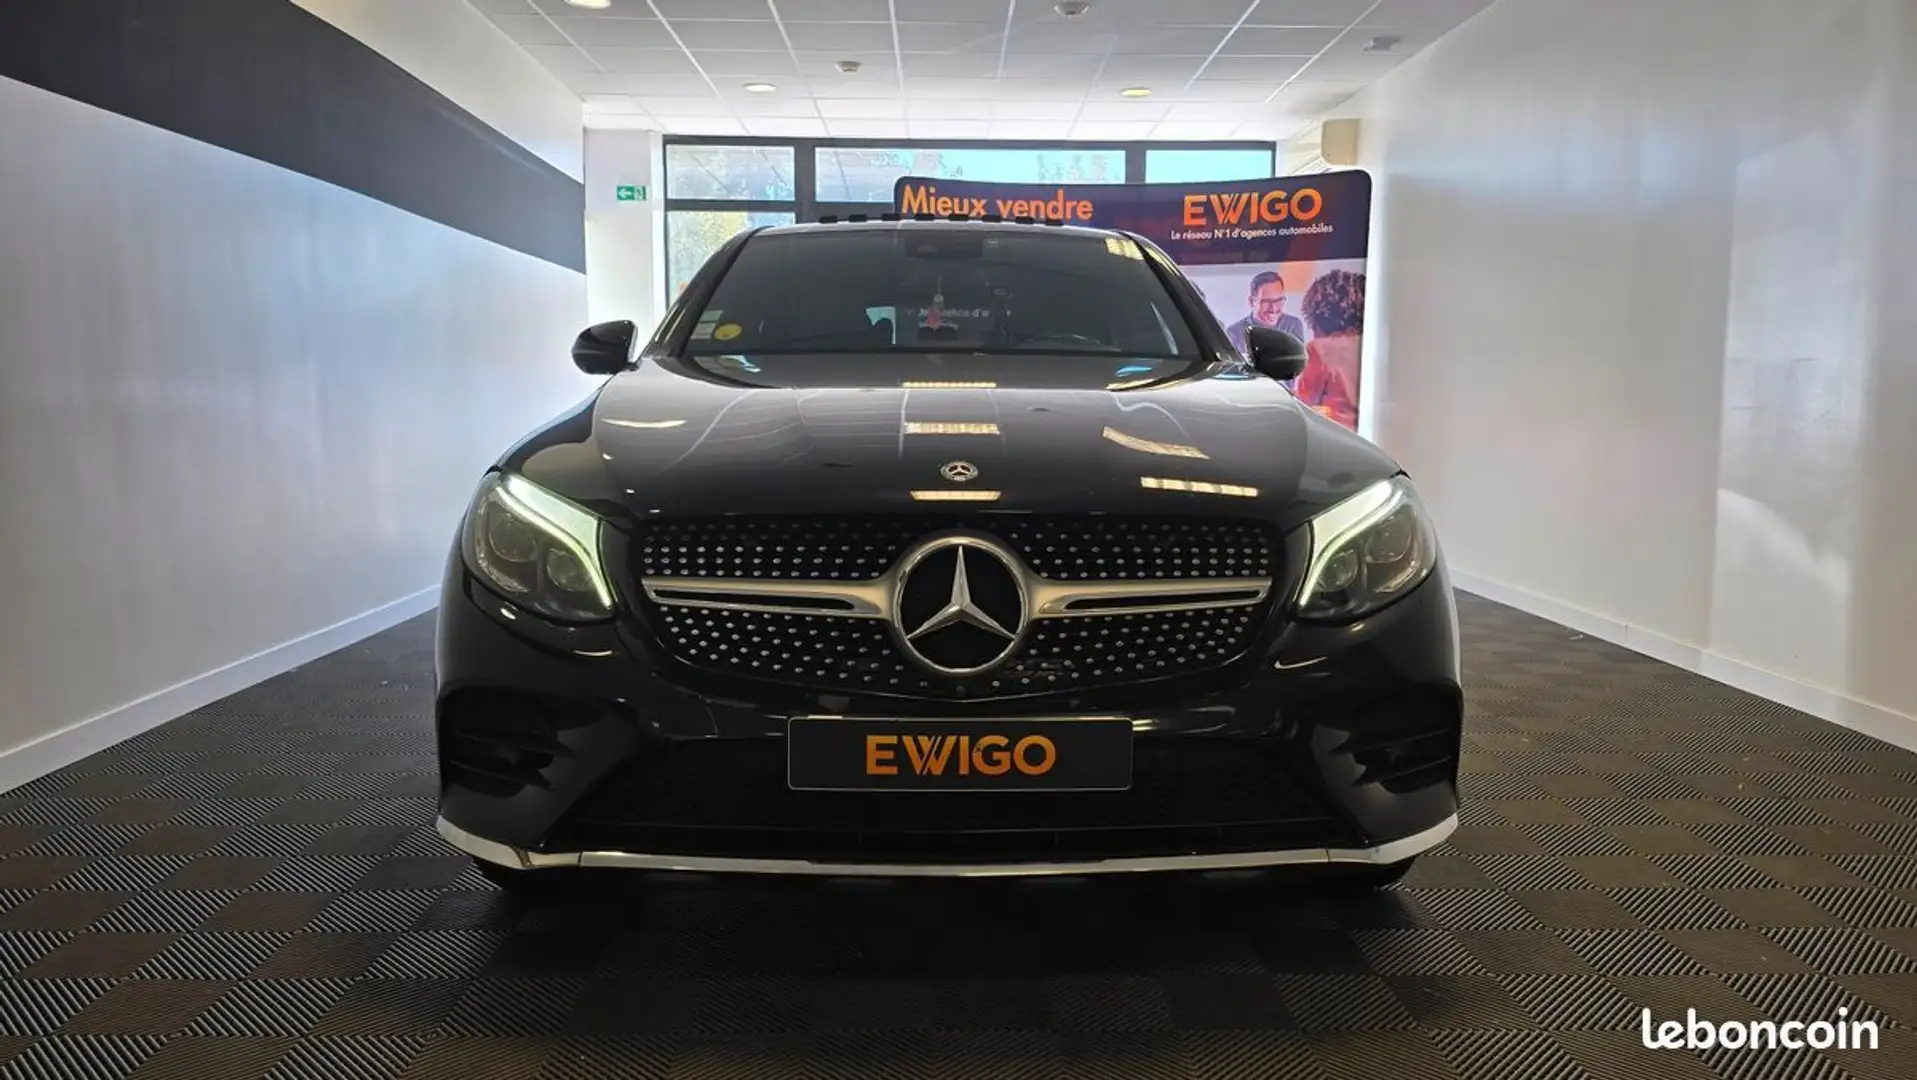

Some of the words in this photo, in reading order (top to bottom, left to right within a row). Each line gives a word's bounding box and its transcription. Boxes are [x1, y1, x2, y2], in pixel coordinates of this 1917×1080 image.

[902, 184, 988, 216] Mieux
[996, 188, 1093, 220] vendre
[1184, 188, 1322, 226] EWIGO
[1171, 230, 1180, 240] Le
[1183, 229, 1211, 240] réseau
[1232, 228, 1276, 241] d'agences
[1278, 223, 1333, 236] automobiles
[866, 735, 1056, 776] EWIGO
